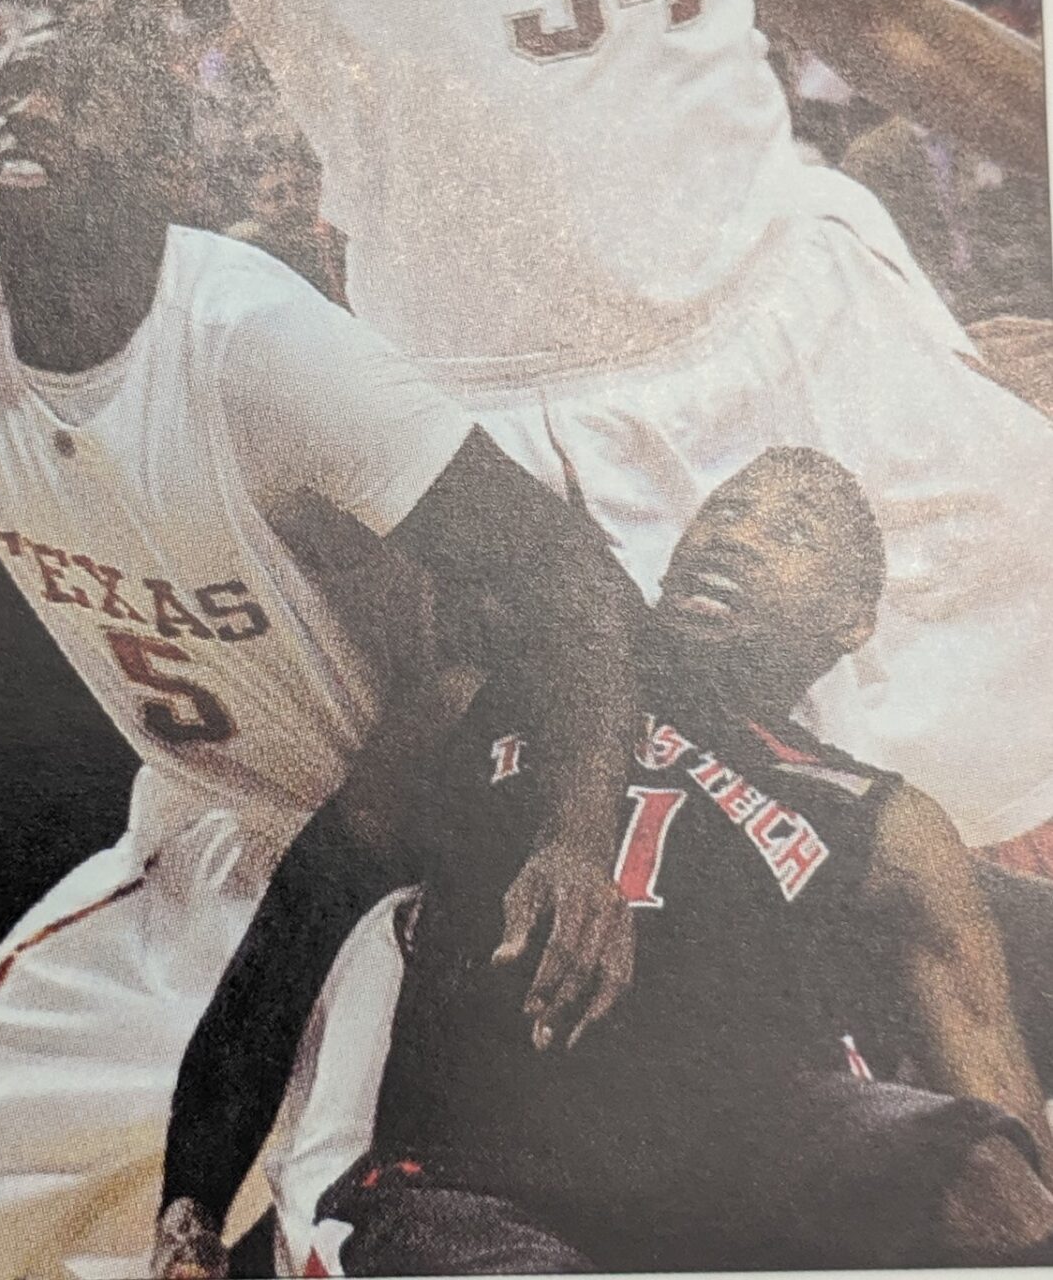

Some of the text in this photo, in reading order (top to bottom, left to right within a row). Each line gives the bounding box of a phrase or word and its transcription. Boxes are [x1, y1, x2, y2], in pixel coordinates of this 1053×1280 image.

[102, 627, 239, 743] 5
[613, 784, 688, 908] 1
[689, 751, 831, 903] TECH
